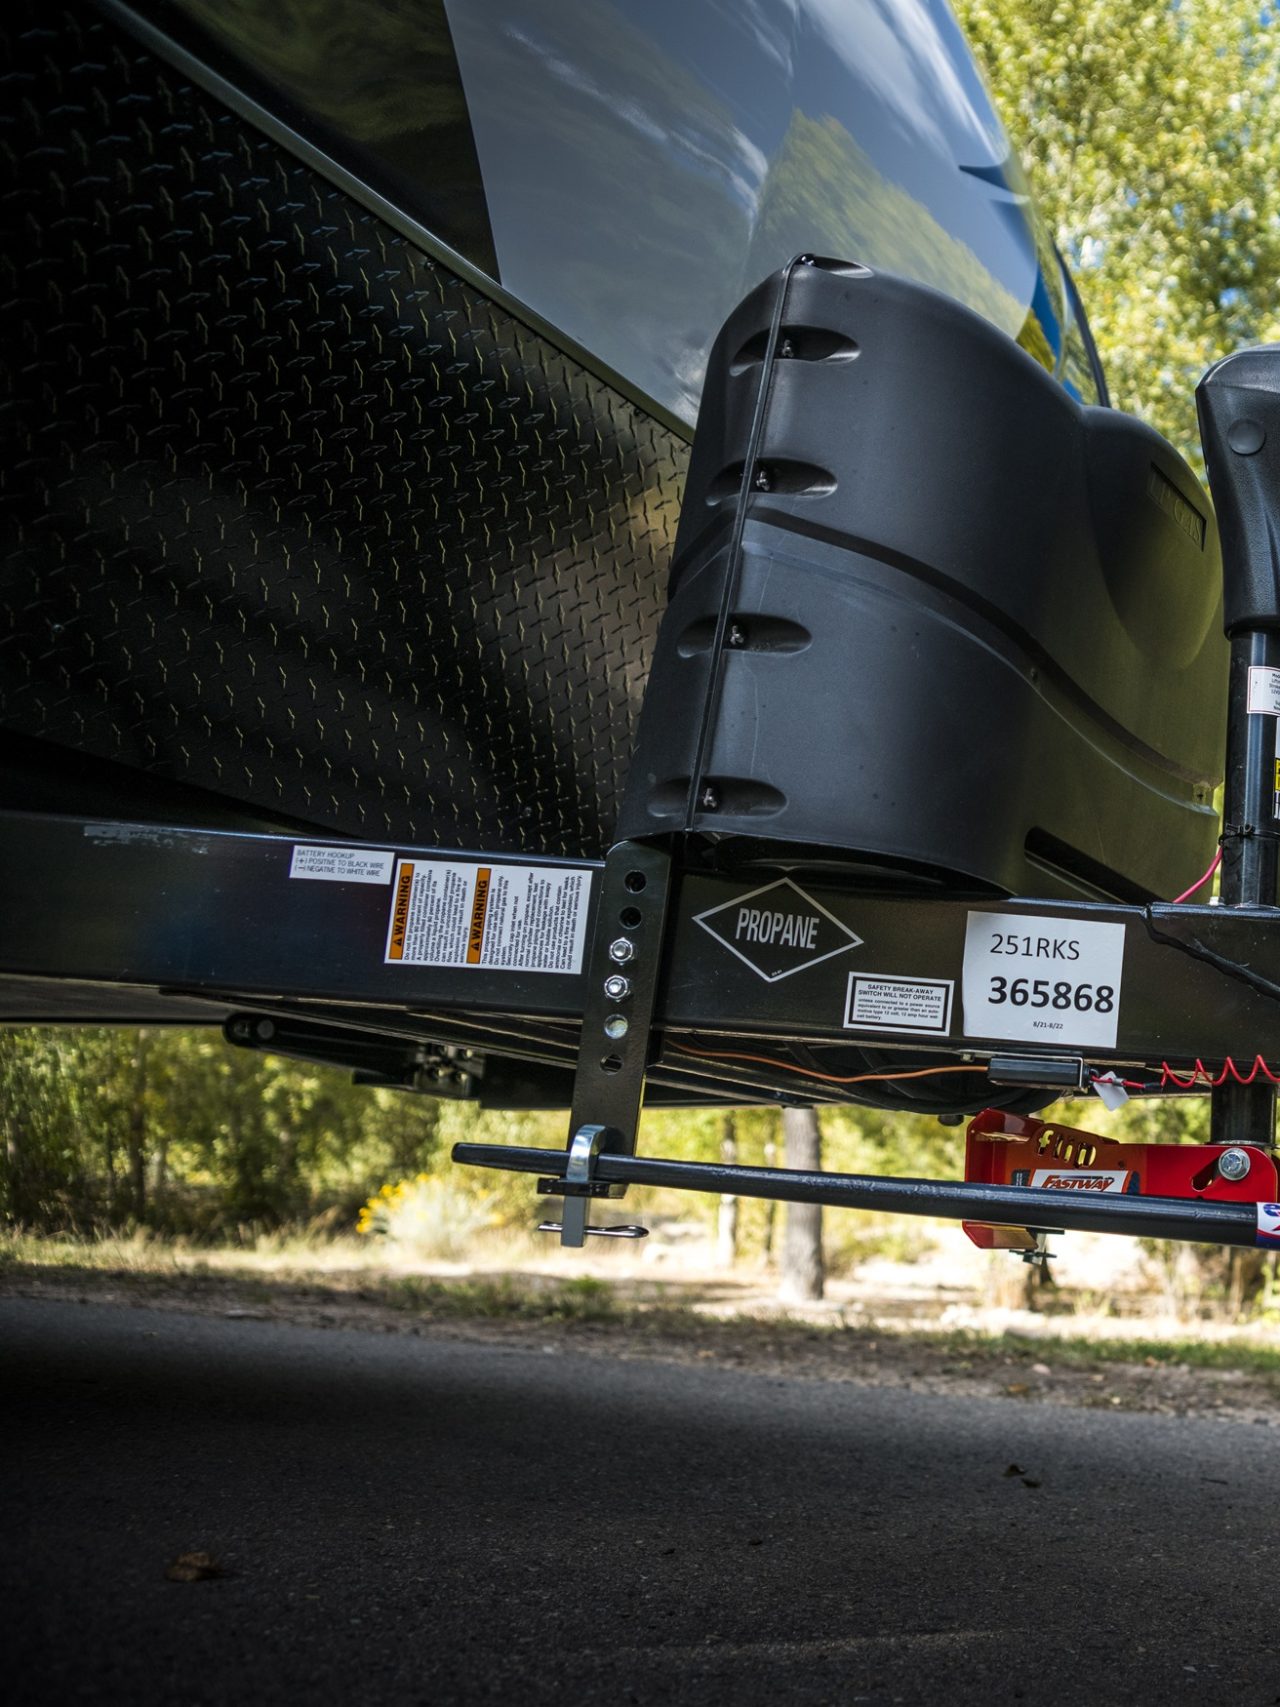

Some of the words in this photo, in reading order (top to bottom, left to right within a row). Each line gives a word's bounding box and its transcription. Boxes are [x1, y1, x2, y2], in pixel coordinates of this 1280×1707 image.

[297, 849, 325, 857] BATTERY
[309, 858, 335, 866] POSITIVE
[394, 875, 410, 936] WARNING
[472, 880, 487, 940] WARNING
[735, 908, 820, 950] PROPANE
[990, 933, 1081, 961] 251RKS
[913, 994, 942, 1002] OPERATE
[987, 976, 1114, 1014] 365868
[1032, 1020, 1064, 1030] 8/21-8/22
[1041, 1175, 1115, 1192] FASTWAY
